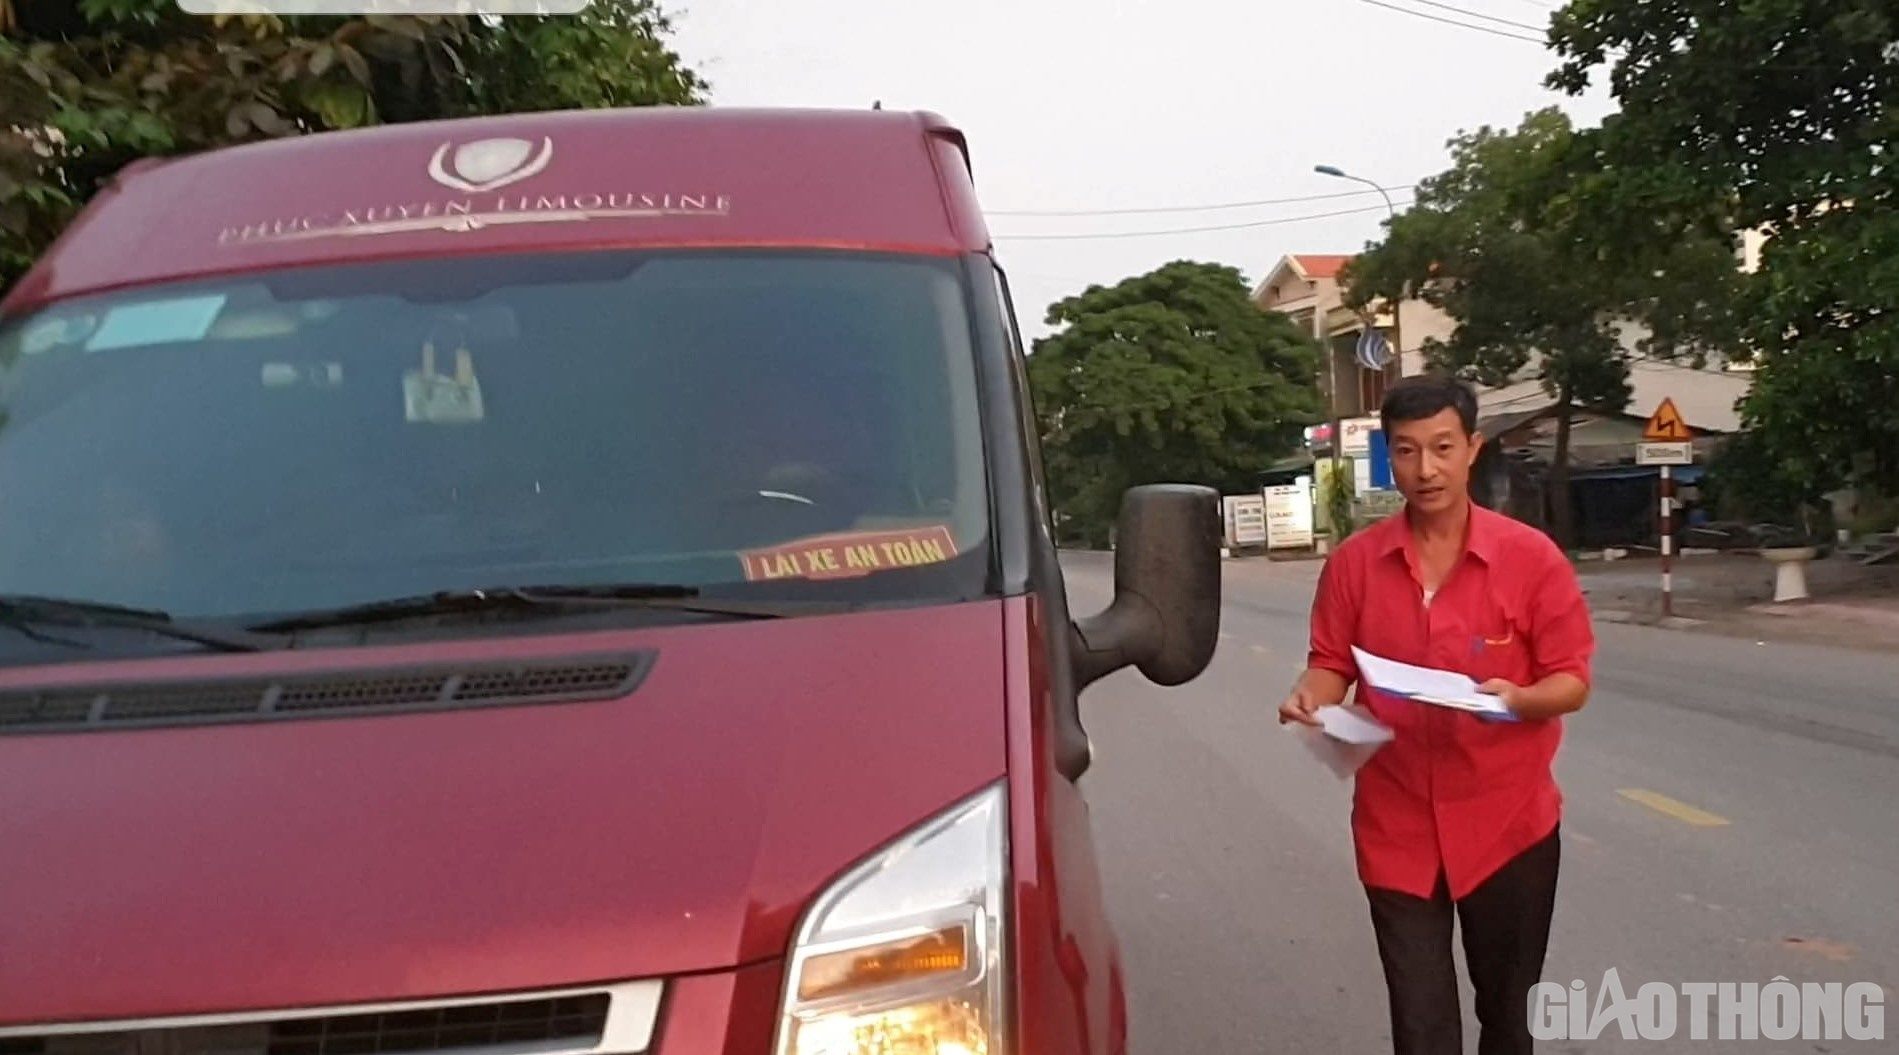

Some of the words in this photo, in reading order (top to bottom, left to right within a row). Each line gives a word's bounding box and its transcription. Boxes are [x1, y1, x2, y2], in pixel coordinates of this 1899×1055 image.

[497, 192, 732, 212] LIMOUSINE
[803, 547, 840, 572] XE
[843, 543, 881, 570] AN
